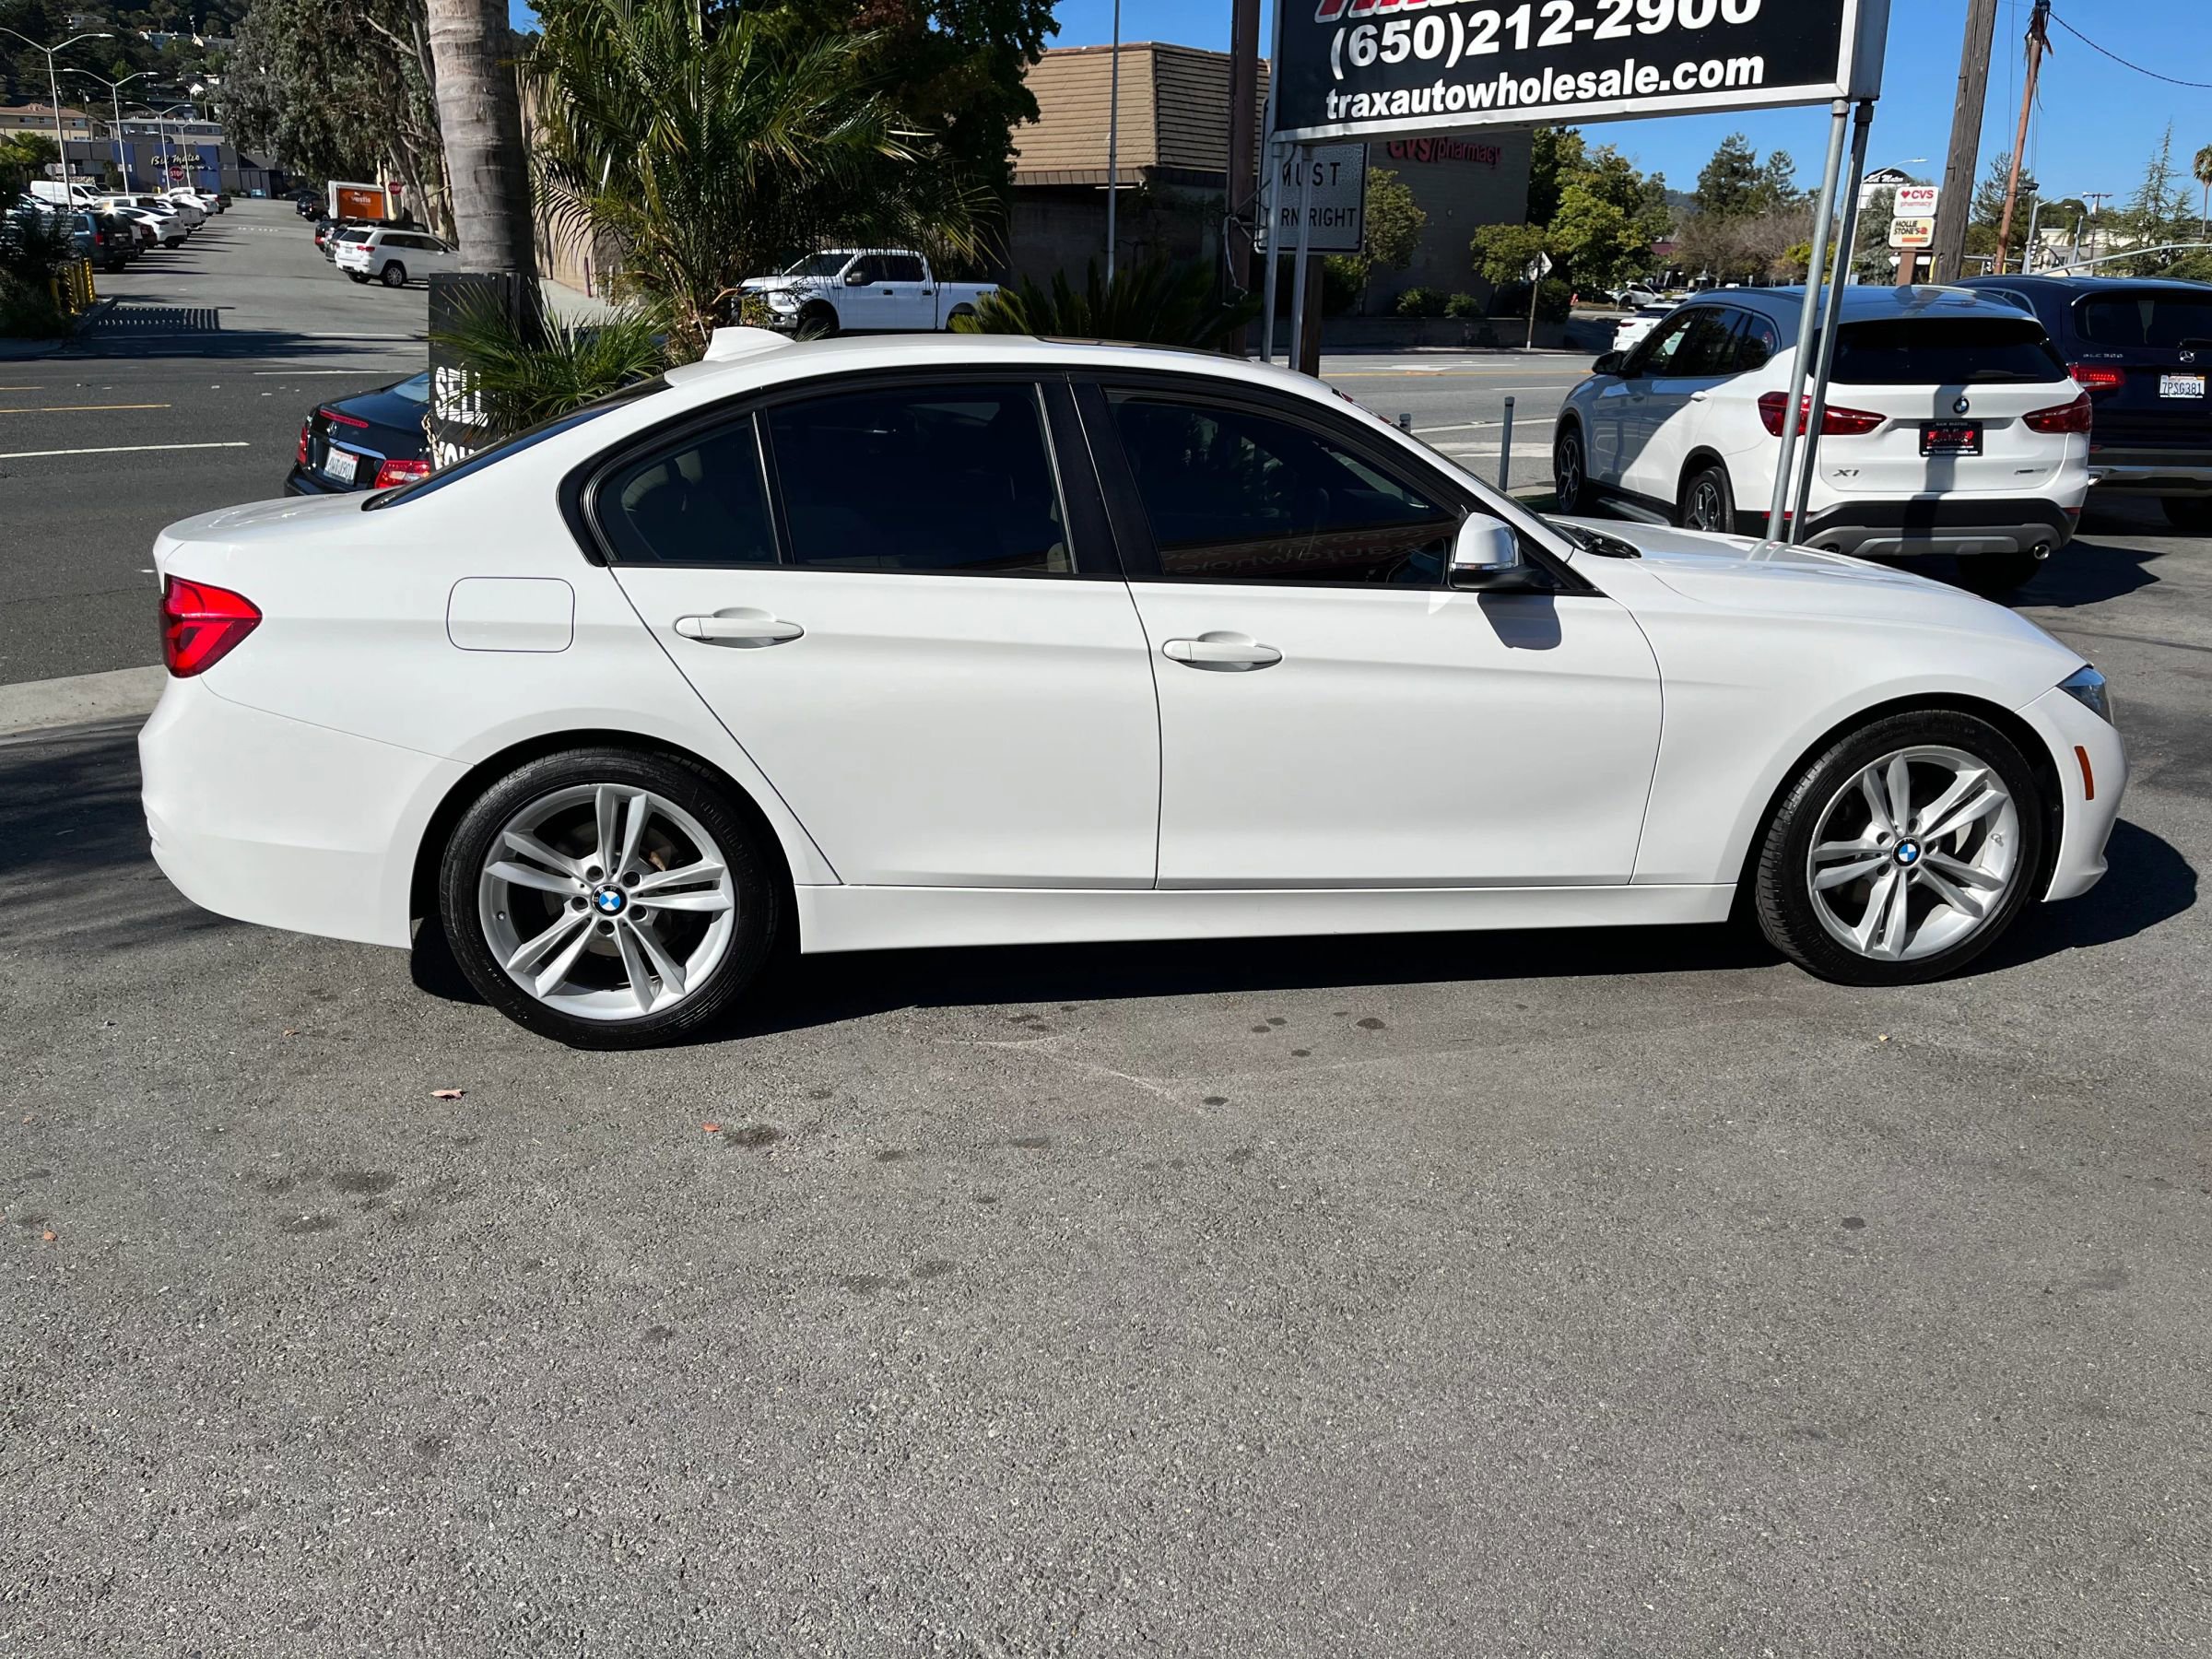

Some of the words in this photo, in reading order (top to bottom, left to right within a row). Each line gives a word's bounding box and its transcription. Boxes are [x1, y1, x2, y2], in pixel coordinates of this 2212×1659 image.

[1330, 0, 1761, 80] (650)212-2900
[1326, 55, 1765, 120] traxautowholesale.com
[1911, 190, 1934, 199] CVS
[1264, 207, 1299, 227] TRN
[1309, 207, 1357, 227] RIGHT
[435, 366, 488, 427] SELL
[2161, 382, 2201, 394] 7PSG381
[431, 441, 475, 470] YO
